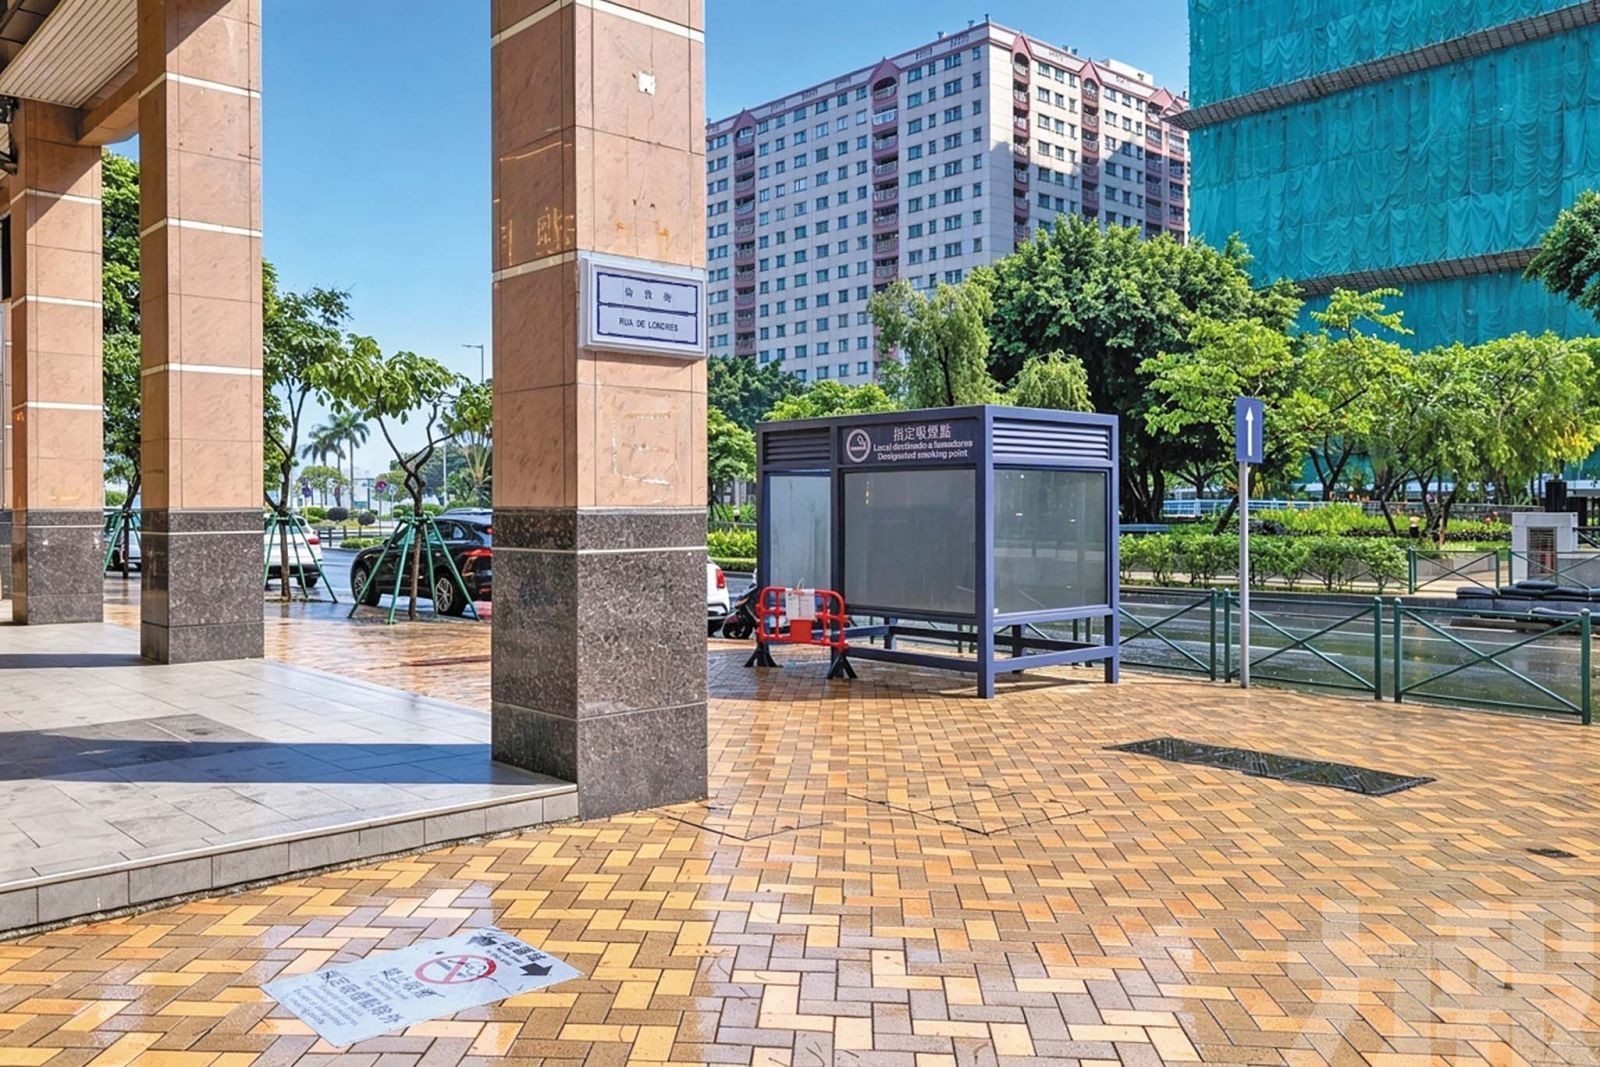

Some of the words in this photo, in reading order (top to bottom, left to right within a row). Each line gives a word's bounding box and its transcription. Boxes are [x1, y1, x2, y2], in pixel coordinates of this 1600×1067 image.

[619, 317, 634, 328] RUA
[636, 319, 646, 328] DE
[647, 320, 679, 332] LONDRES
[893, 423, 952, 442] 指定吸煙點
[873, 443, 892, 452] Local
[892, 441, 927, 451] destinado
[933, 439, 973, 449] fumadores
[877, 451, 916, 461] Designated
[917, 450, 948, 460] smoking
[948, 449, 968, 459] point
